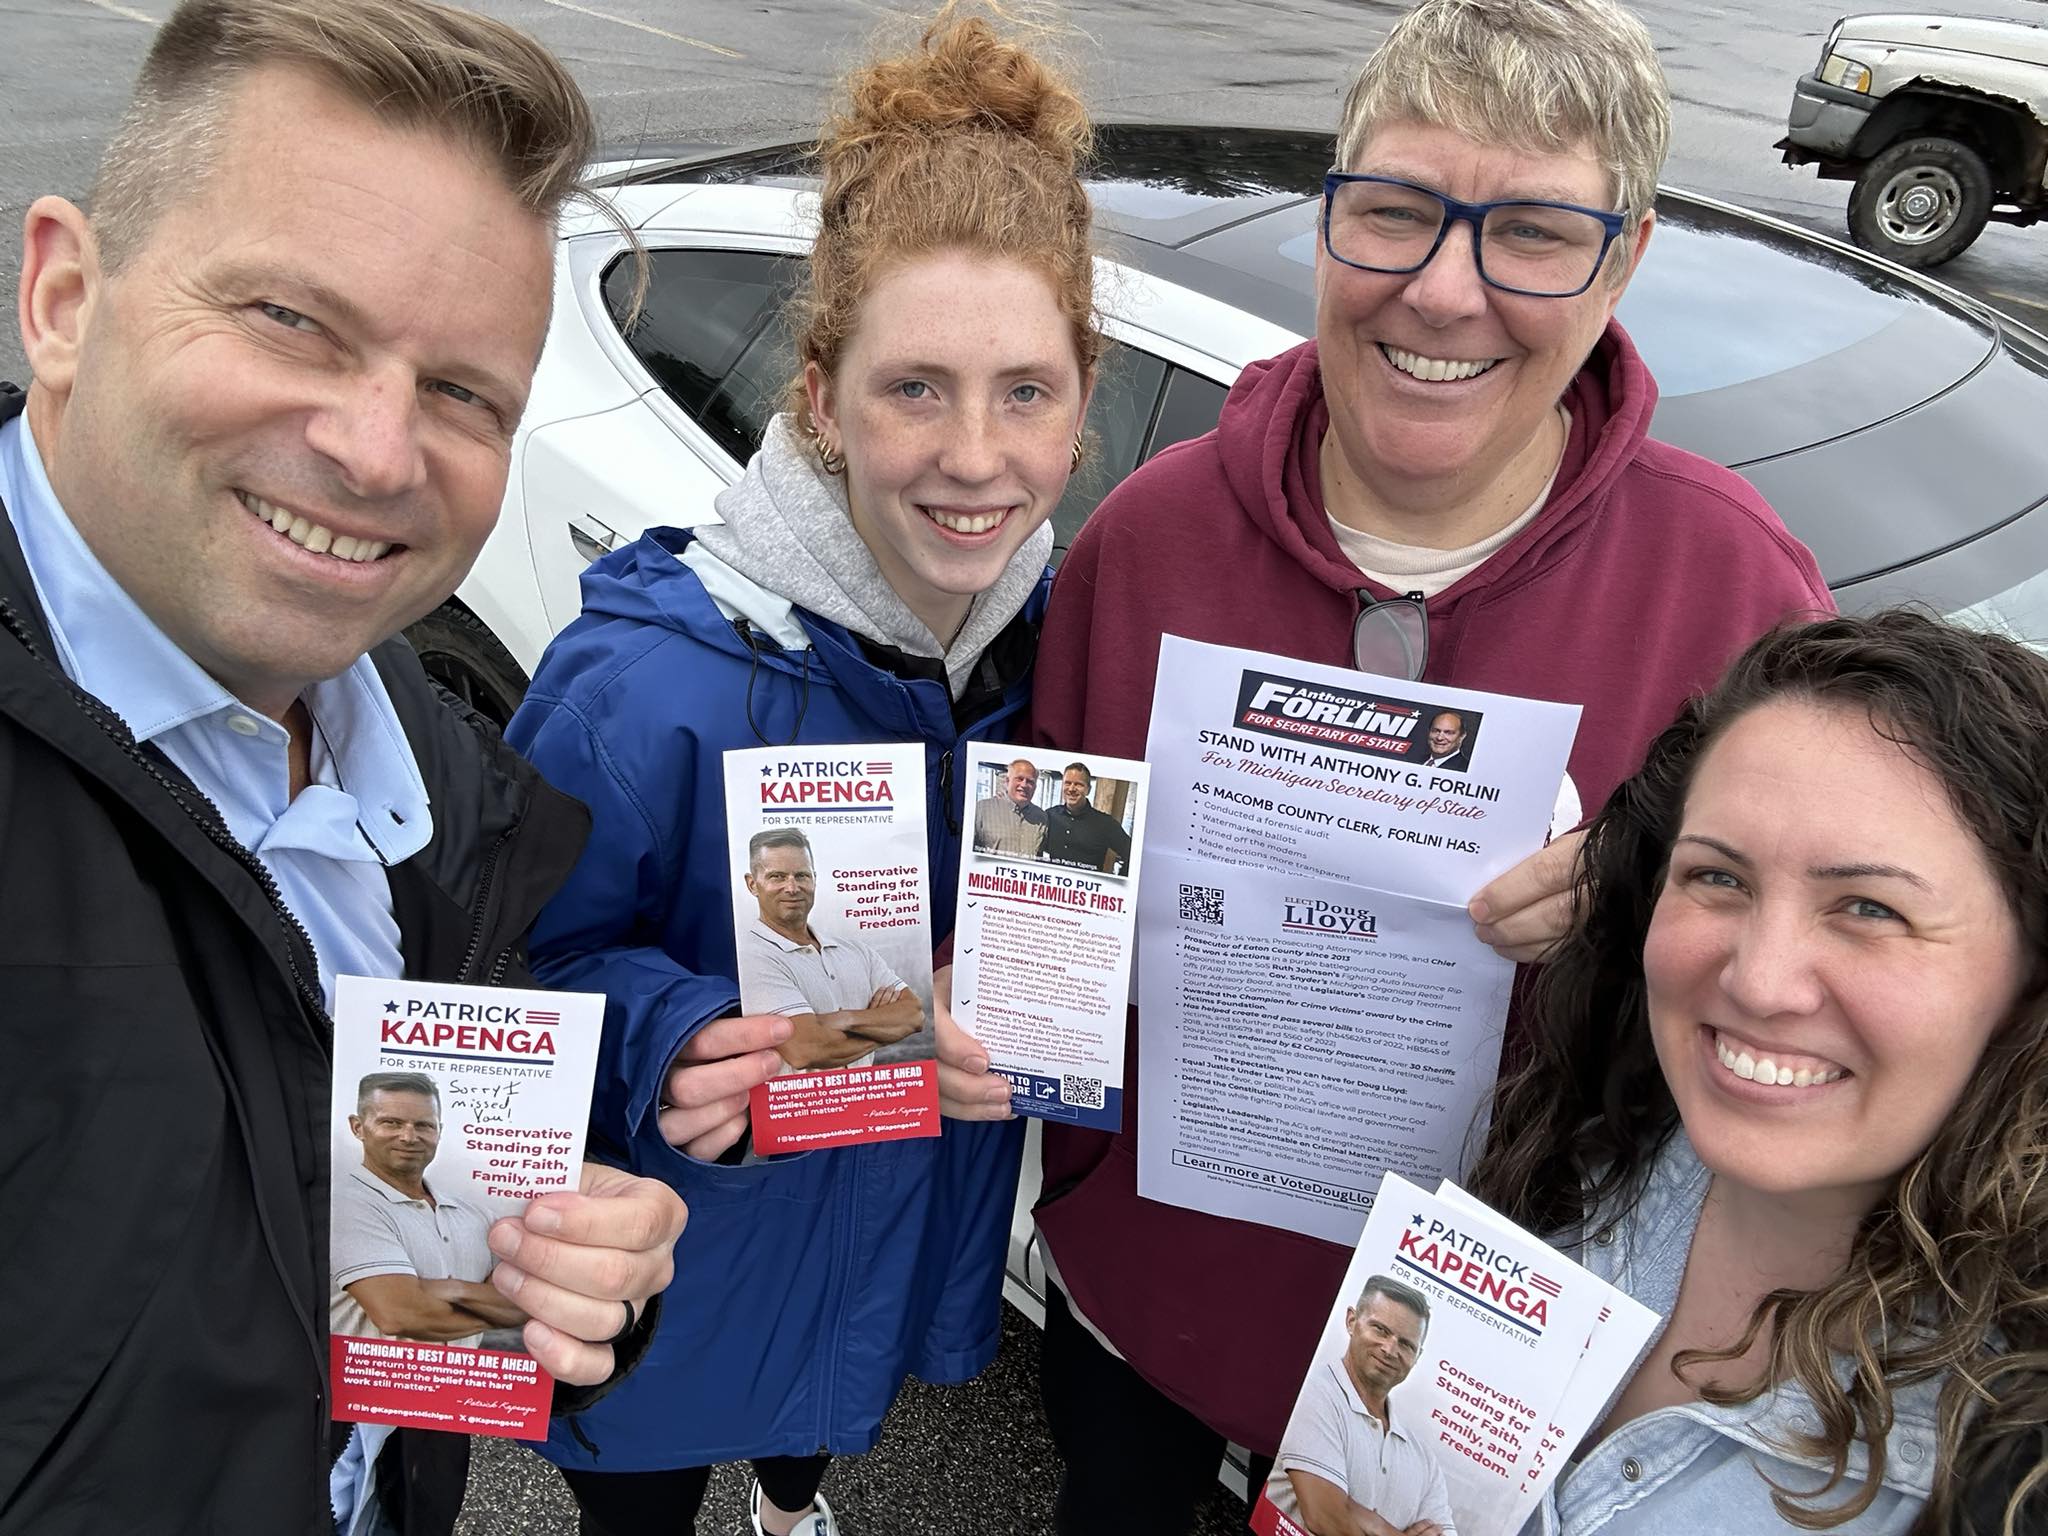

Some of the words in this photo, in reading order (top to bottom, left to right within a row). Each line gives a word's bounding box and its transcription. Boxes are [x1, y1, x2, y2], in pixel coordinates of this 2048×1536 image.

[1249, 681, 1418, 737] FORLINI
[1295, 688, 1367, 709] Anthony
[1247, 713, 1274, 726] FOR
[1273, 718, 1347, 742] SECRETARY
[1347, 733, 1366, 744] OF
[1366, 737, 1406, 752] STATE
[778, 761, 863, 778] PATRICK
[1198, 730, 1255, 753] STAND
[1261, 743, 1306, 765] WITH
[1310, 755, 1401, 784] ANTHONY
[1405, 773, 1422, 788] G.
[1429, 777, 1500, 802] FORLINI
[761, 780, 893, 803] KAPENGA
[1201, 750, 1235, 769] For
[1237, 758, 1326, 790] Michigan
[1325, 779, 1415, 811] Secretary
[1416, 797, 1440, 815] of
[1438, 800, 1487, 820] State
[785, 816, 811, 824] STATE
[815, 815, 893, 824] REPRESENTATIVE
[1192, 782, 1210, 795] AS
[1213, 787, 1274, 811] MACOMB
[1277, 803, 1334, 826] COUNTY
[1337, 817, 1383, 839] CLERK,
[1388, 828, 1443, 848] FORLINI
[1446, 838, 1481, 854] HAS:
[1202, 813, 1263, 836] Watermarked
[1265, 831, 1297, 845] ballots
[1204, 801, 1255, 821] Conducted
[1264, 817, 1303, 833] forensic
[1304, 827, 1331, 840] audit
[1200, 825, 1232, 841] Turned
[1234, 835, 1247, 844] off
[1250, 839, 1265, 848] the
[1267, 843, 1308, 859] modems
[1198, 848, 1236, 865] Referred
[1238, 859, 1265, 869] those
[1199, 837, 1224, 850] Made
[1225, 845, 1268, 859] elections
[1270, 855, 1294, 866] more
[1296, 860, 1351, 881] transparent
[832, 866, 918, 879] Conservative
[995, 866, 1017, 877] IT'S
[1022, 870, 1051, 883] TIME
[1056, 876, 1072, 887] TO
[1077, 880, 1102, 892] PUT
[837, 881, 896, 892] Standing
[900, 879, 919, 888] for
[968, 873, 1026, 896] MICHIGAN
[1031, 885, 1086, 906] FAMILIES
[1090, 895, 1126, 913] FIRST.
[857, 895, 880, 904] our
[883, 892, 919, 902] Faith,
[1285, 896, 1314, 906] ELECT
[1315, 900, 1370, 920] Doug
[845, 907, 892, 918] Family,
[895, 904, 919, 913] and
[984, 905, 1005, 914] GROW
[1006, 909, 1045, 922] MICHIGAN'S
[1047, 916, 1081, 927] ECONOMY
[1284, 904, 1377, 934] Lloyd
[860, 917, 920, 929] Freedom.
[1036, 963, 1066, 973] FUTURES
[407, 1000, 522, 1024] PATRICK
[977, 1004, 1026, 1018] CONSERVATIVE
[1028, 1014, 1053, 1023] VALUES
[380, 1019, 556, 1055] KAPENGA
[380, 1057, 404, 1068] FOR
[409, 1060, 445, 1072] STATE
[450, 1063, 552, 1078] REPRESENTATIVE
[825, 1074, 847, 1087] BEST
[850, 1072, 872, 1083] DAYS
[874, 1070, 891, 1081] ARE
[893, 1066, 922, 1079] AHEAD
[1231, 1058, 1284, 1072] Expectations
[1286, 1066, 1301, 1075] you
[1303, 1071, 1319, 1079] can
[1321, 1074, 1341, 1083] have
[1343, 1077, 1354, 1085] for
[1357, 1080, 1380, 1091] Doug
[449, 1080, 500, 1097] Sorry
[791, 1092, 816, 1100] return
[829, 1086, 866, 1095] common
[896, 1080, 924, 1088] strong
[1012, 1085, 1030, 1096] ORE
[1017, 1077, 1030, 1086] TO
[451, 1097, 510, 1109] missed
[463, 1124, 572, 1140] Conservative
[466, 1140, 543, 1155] Standing
[547, 1143, 571, 1155] for
[489, 1158, 518, 1168] our
[522, 1158, 568, 1172] Faith,
[1183, 1155, 1220, 1171] Learn
[1224, 1165, 1259, 1179] more
[1263, 1173, 1277, 1184] at
[472, 1170, 529, 1186] Family,
[535, 1174, 566, 1185] and
[487, 1186, 551, 1201] Freedo
[1428, 1219, 1529, 1283] PATRICK
[1399, 1229, 1548, 1327] KAPENGA
[1390, 1263, 1410, 1280] FOR
[1413, 1276, 1445, 1300] STATE
[1447, 1296, 1538, 1349] REPRESENTATIVE
[345, 1356, 352, 1364] if
[372, 1359, 403, 1369] return
[407, 1363, 418, 1371] to
[420, 1364, 466, 1376] common
[469, 1370, 500, 1380] sense,
[503, 1373, 536, 1384] strong
[418, 1349, 444, 1363] BEST
[447, 1352, 475, 1366] DAYS
[478, 1355, 499, 1369] ARE
[502, 1358, 537, 1372] AHEAD
[344, 1366, 388, 1379] families,
[391, 1371, 410, 1380] and
[413, 1373, 430, 1382] the
[433, 1375, 462, 1386] belief
[465, 1379, 486, 1388] that
[489, 1381, 512, 1390] hard
[344, 1377, 370, 1386] work
[373, 1379, 391, 1388] still
[1439, 1360, 1536, 1419] Conservative
[1436, 1376, 1504, 1422] Standing
[1508, 1416, 1531, 1433] for
[1432, 1409, 1483, 1447] Family,
[1488, 1442, 1518, 1464] and
[1452, 1405, 1478, 1422] our
[1481, 1419, 1522, 1450] Faith,
[1440, 1432, 1509, 1478] Freedom.
